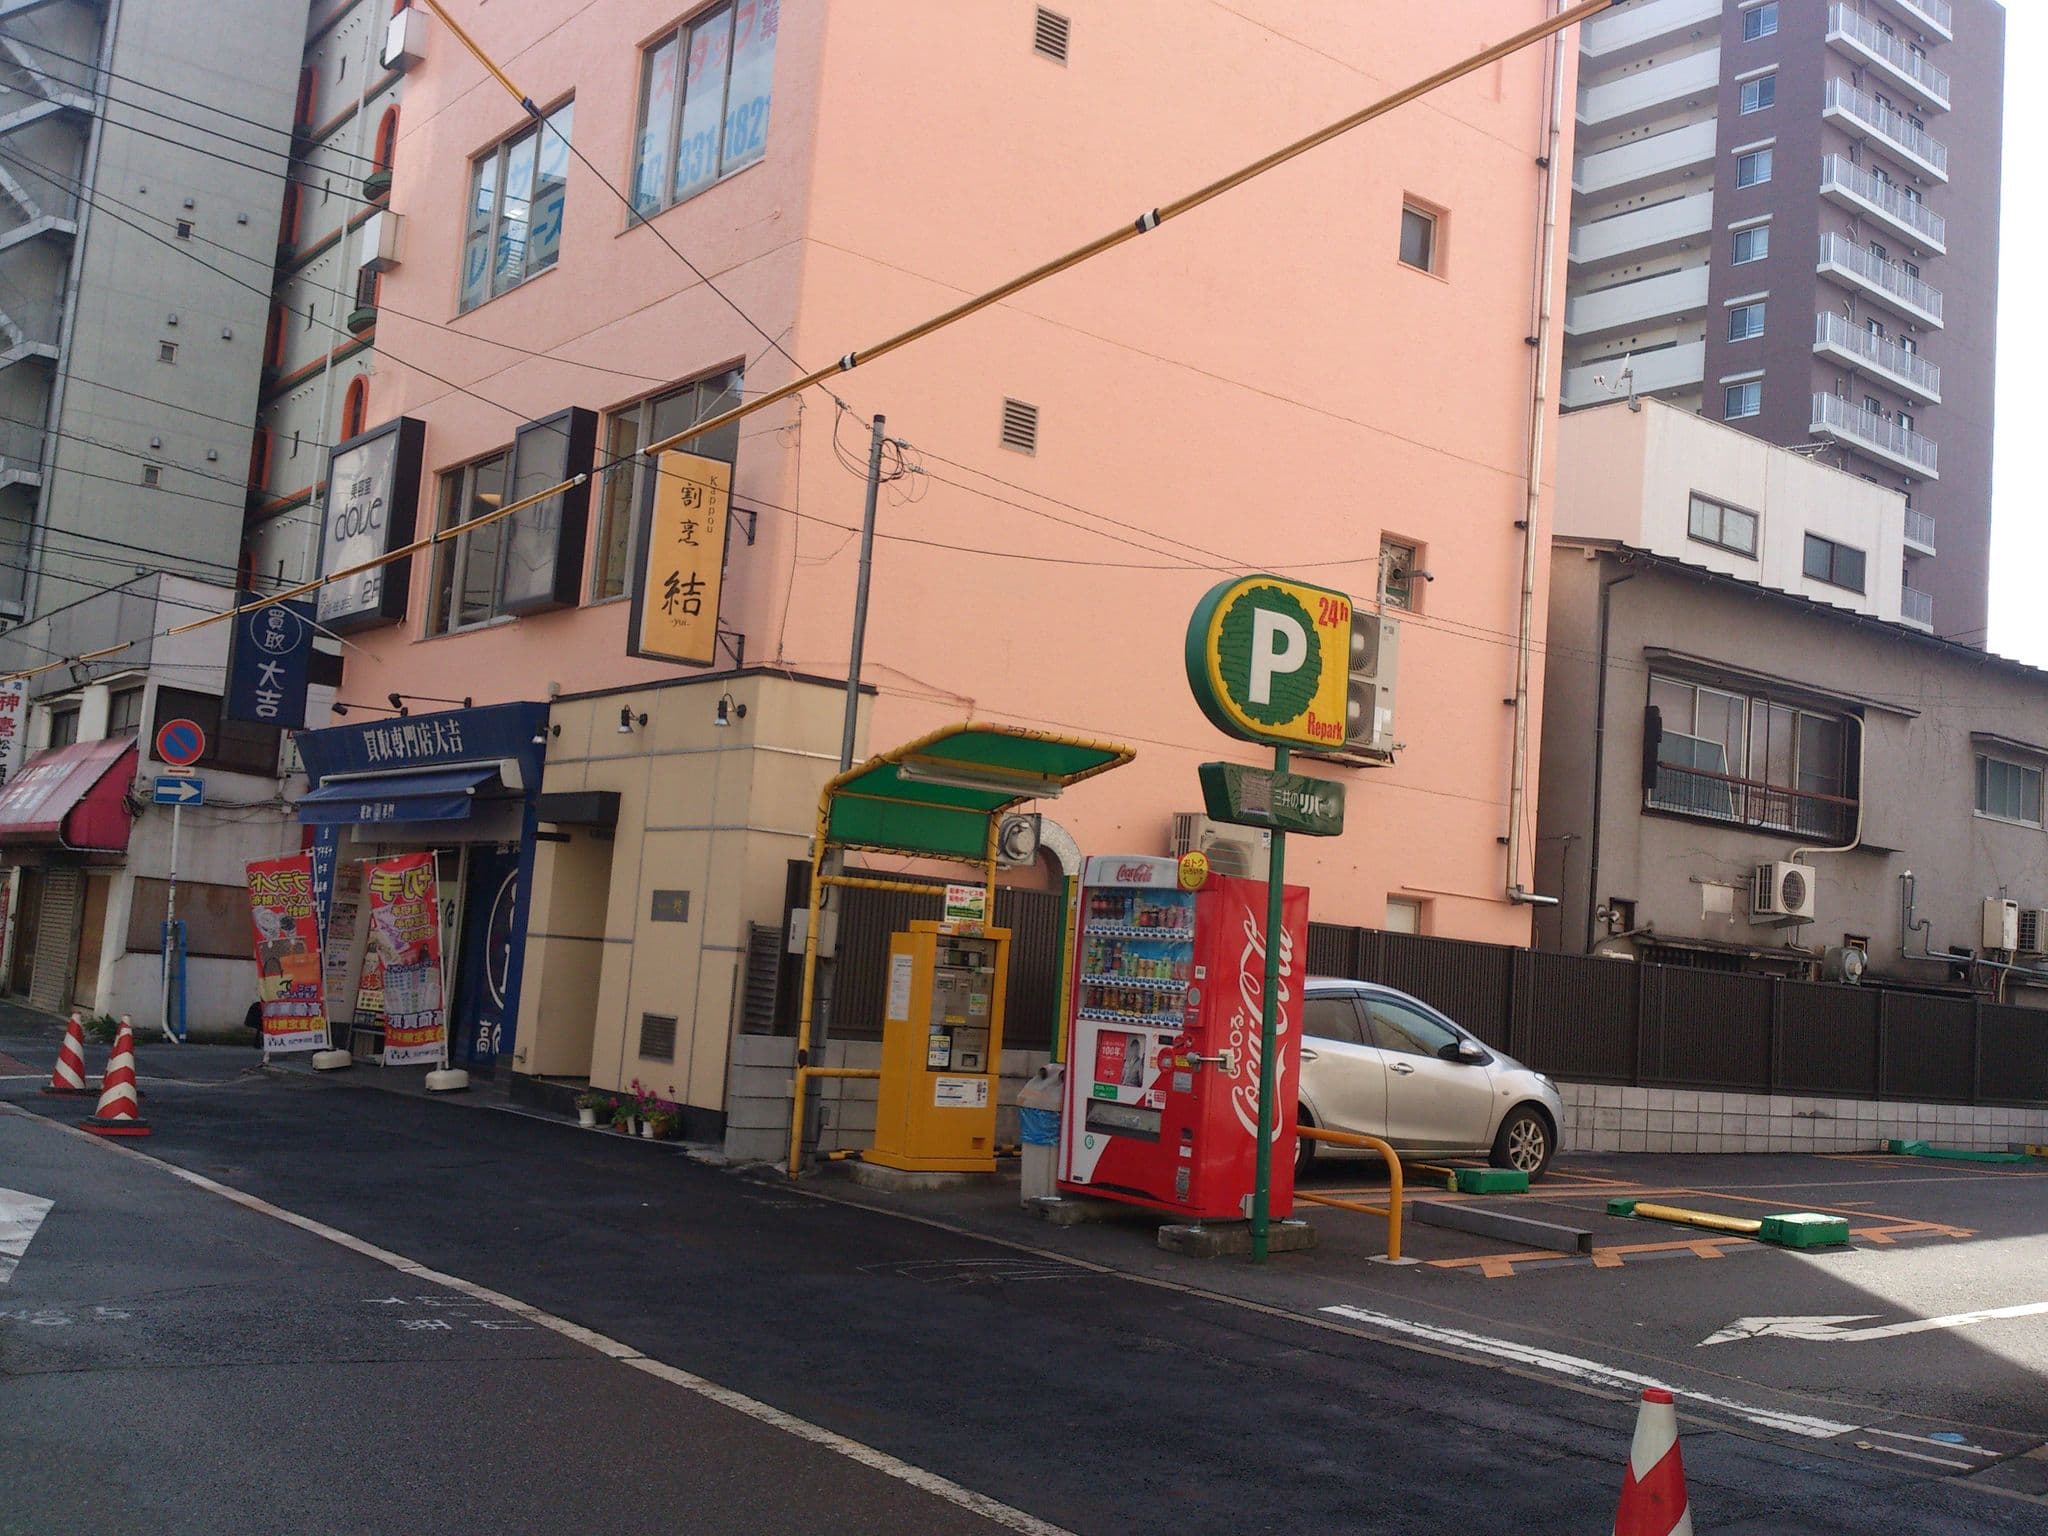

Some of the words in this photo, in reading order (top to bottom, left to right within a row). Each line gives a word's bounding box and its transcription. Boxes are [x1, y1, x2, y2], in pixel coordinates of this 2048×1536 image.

[661, 570, 706, 617] 結
[1318, 596, 1349, 629] 24h
[264, 608, 286, 651] 買取
[1248, 607, 1308, 705] P
[255, 660, 286, 718] 大吉
[362, 719, 464, 762] 買取専門店大吉
[1307, 711, 1343, 740] Repark
[1116, 864, 1153, 883] Coca-Cola
